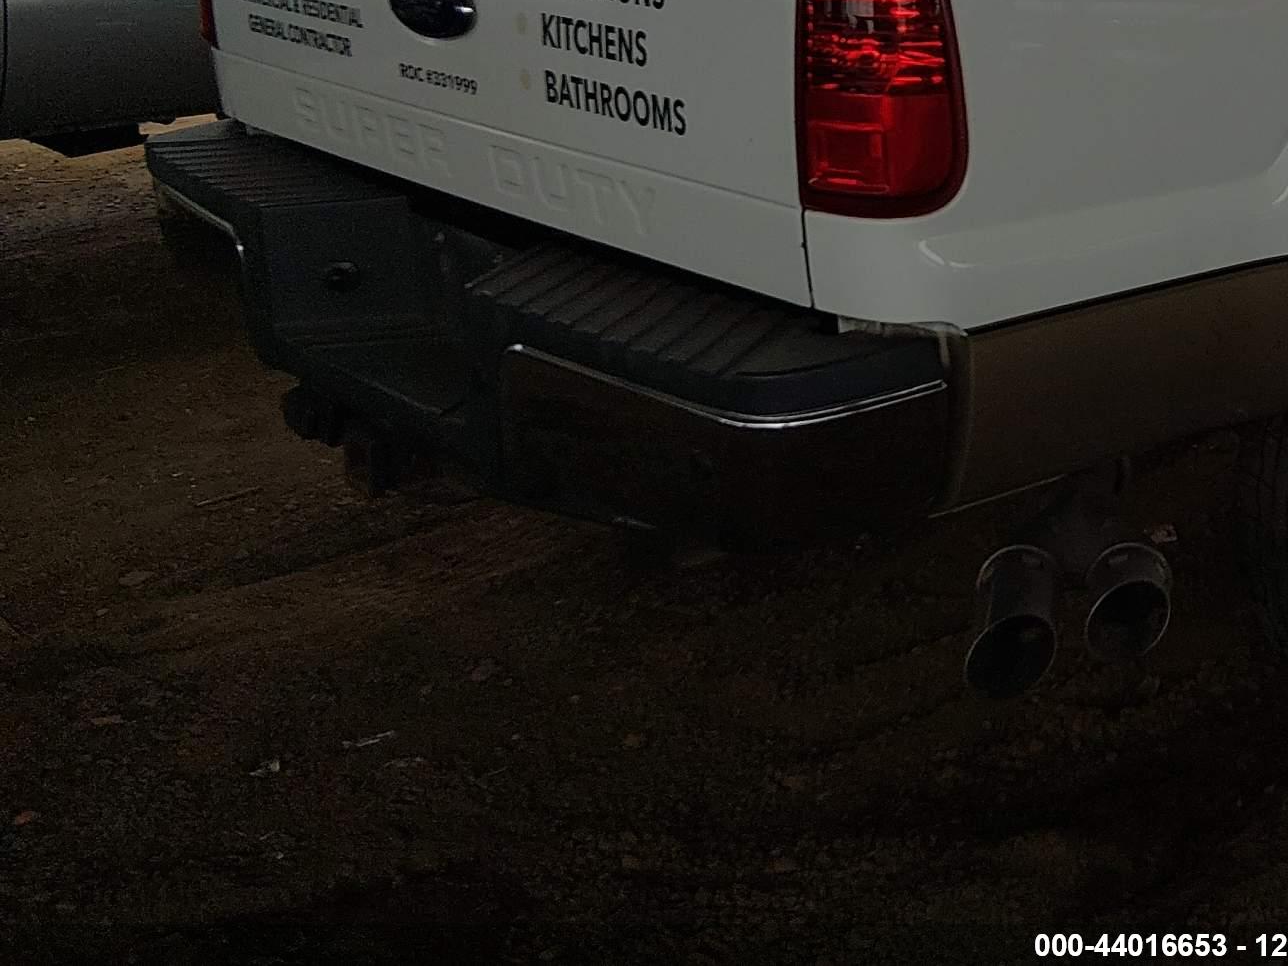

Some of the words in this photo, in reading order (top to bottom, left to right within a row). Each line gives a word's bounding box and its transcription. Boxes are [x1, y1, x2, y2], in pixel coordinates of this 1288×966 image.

[287, 23, 353, 57] CONTRACTOR
[541, 13, 647, 66] KITCHENS
[544, 70, 687, 136] BATHROOMS
[292, 83, 455, 180] SUPER
[486, 143, 660, 236] DUTY
